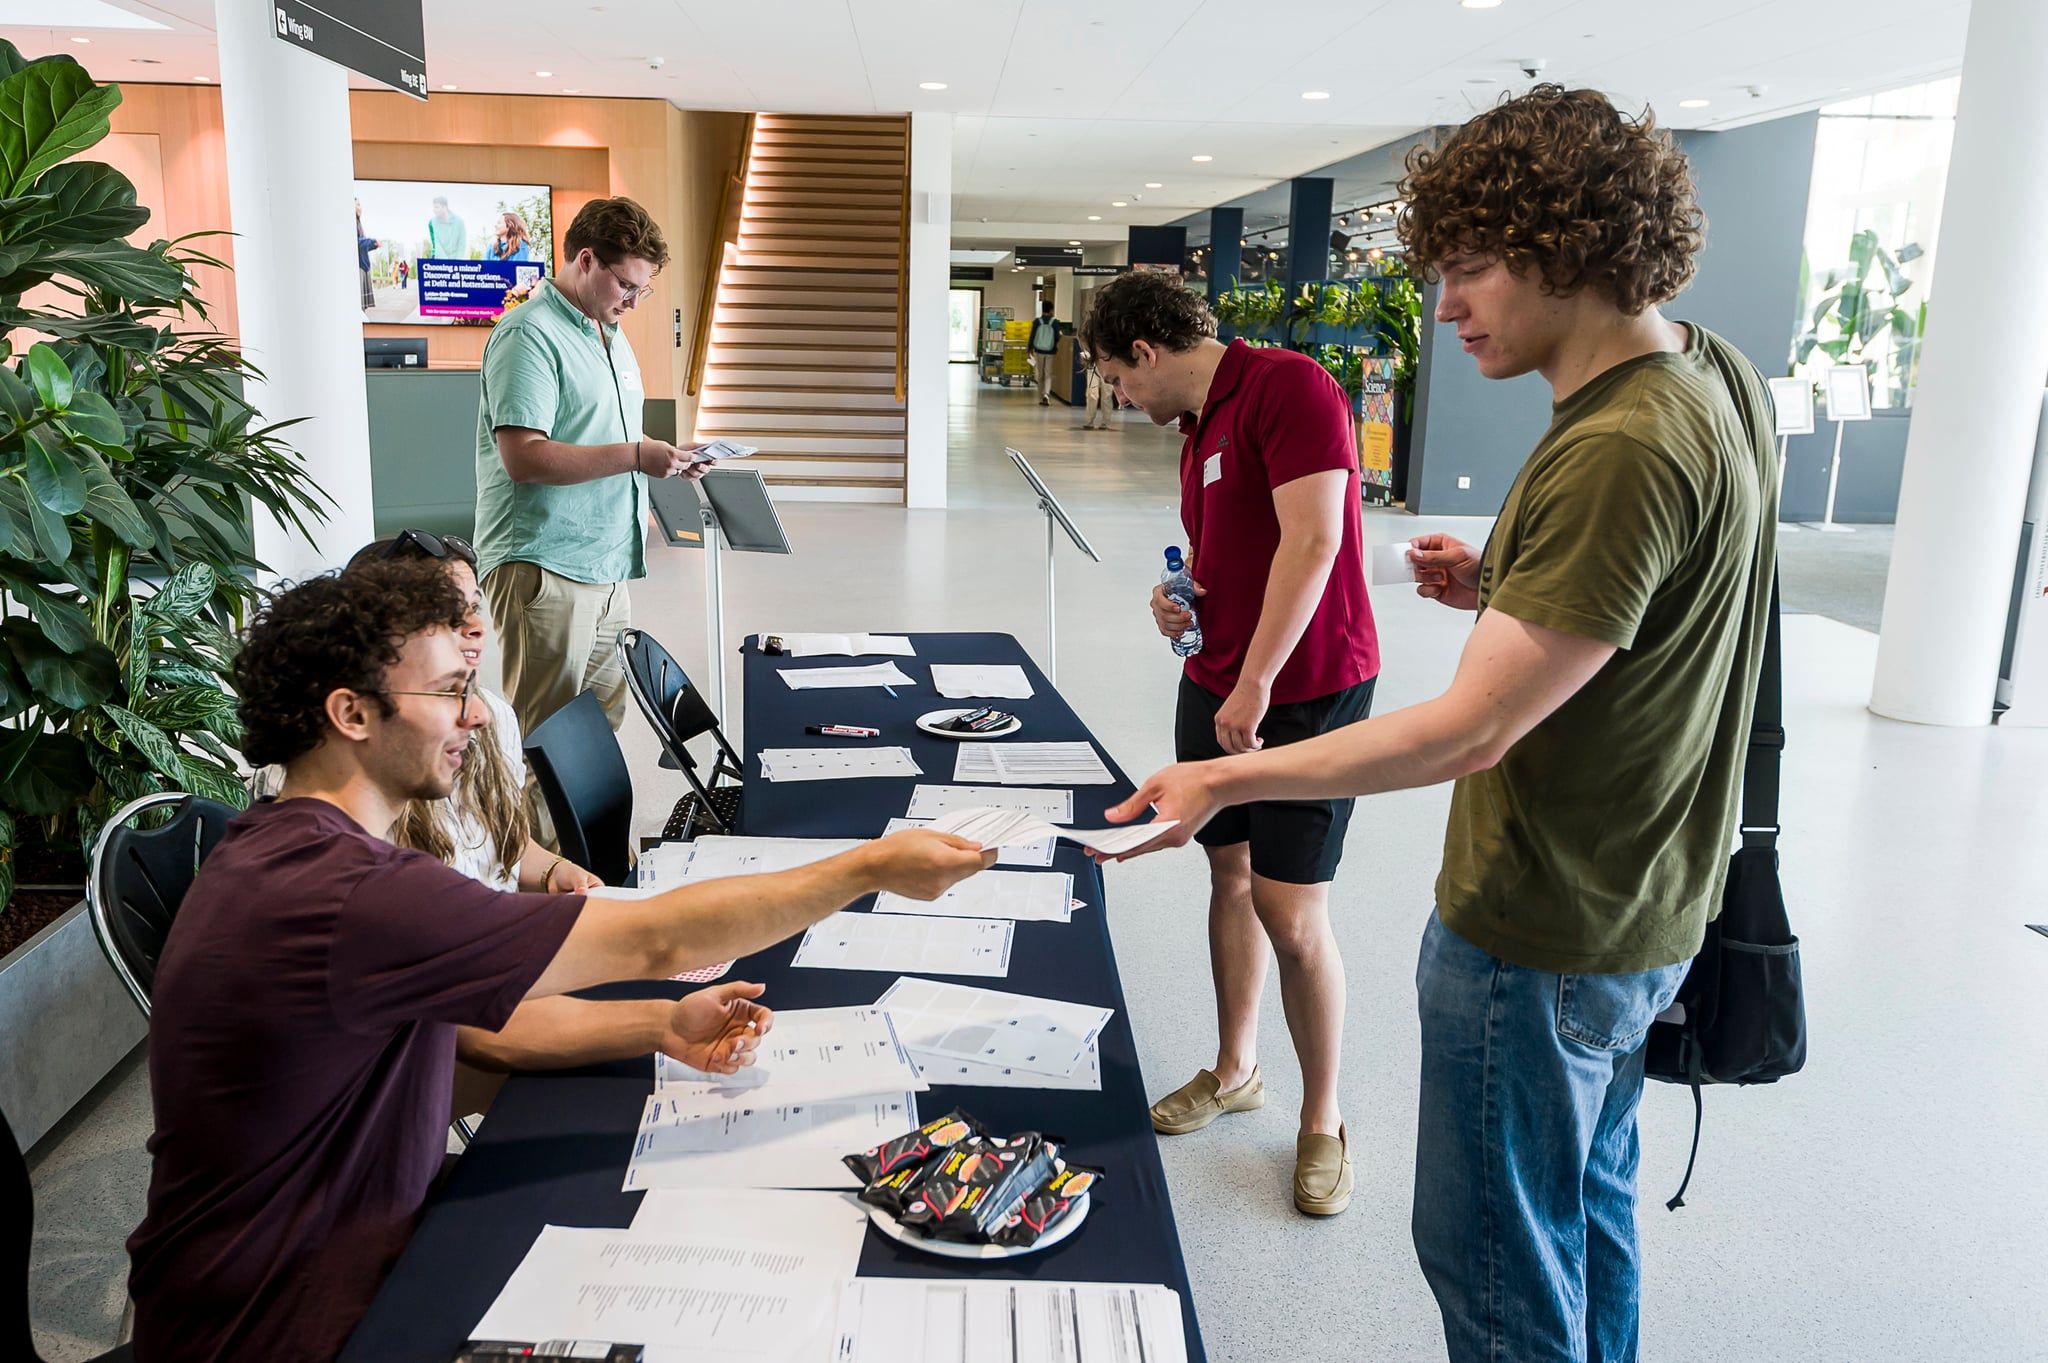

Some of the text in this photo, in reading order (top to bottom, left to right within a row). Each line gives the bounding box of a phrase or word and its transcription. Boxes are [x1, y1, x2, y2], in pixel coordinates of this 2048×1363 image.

[287, 16, 314, 42] Wing BW
[400, 69, 412, 88] Wing
[423, 264, 453, 272] Choosing
[461, 274, 475, 282] your
[476, 273, 500, 282] options
[1365, 380, 1386, 394] Science
